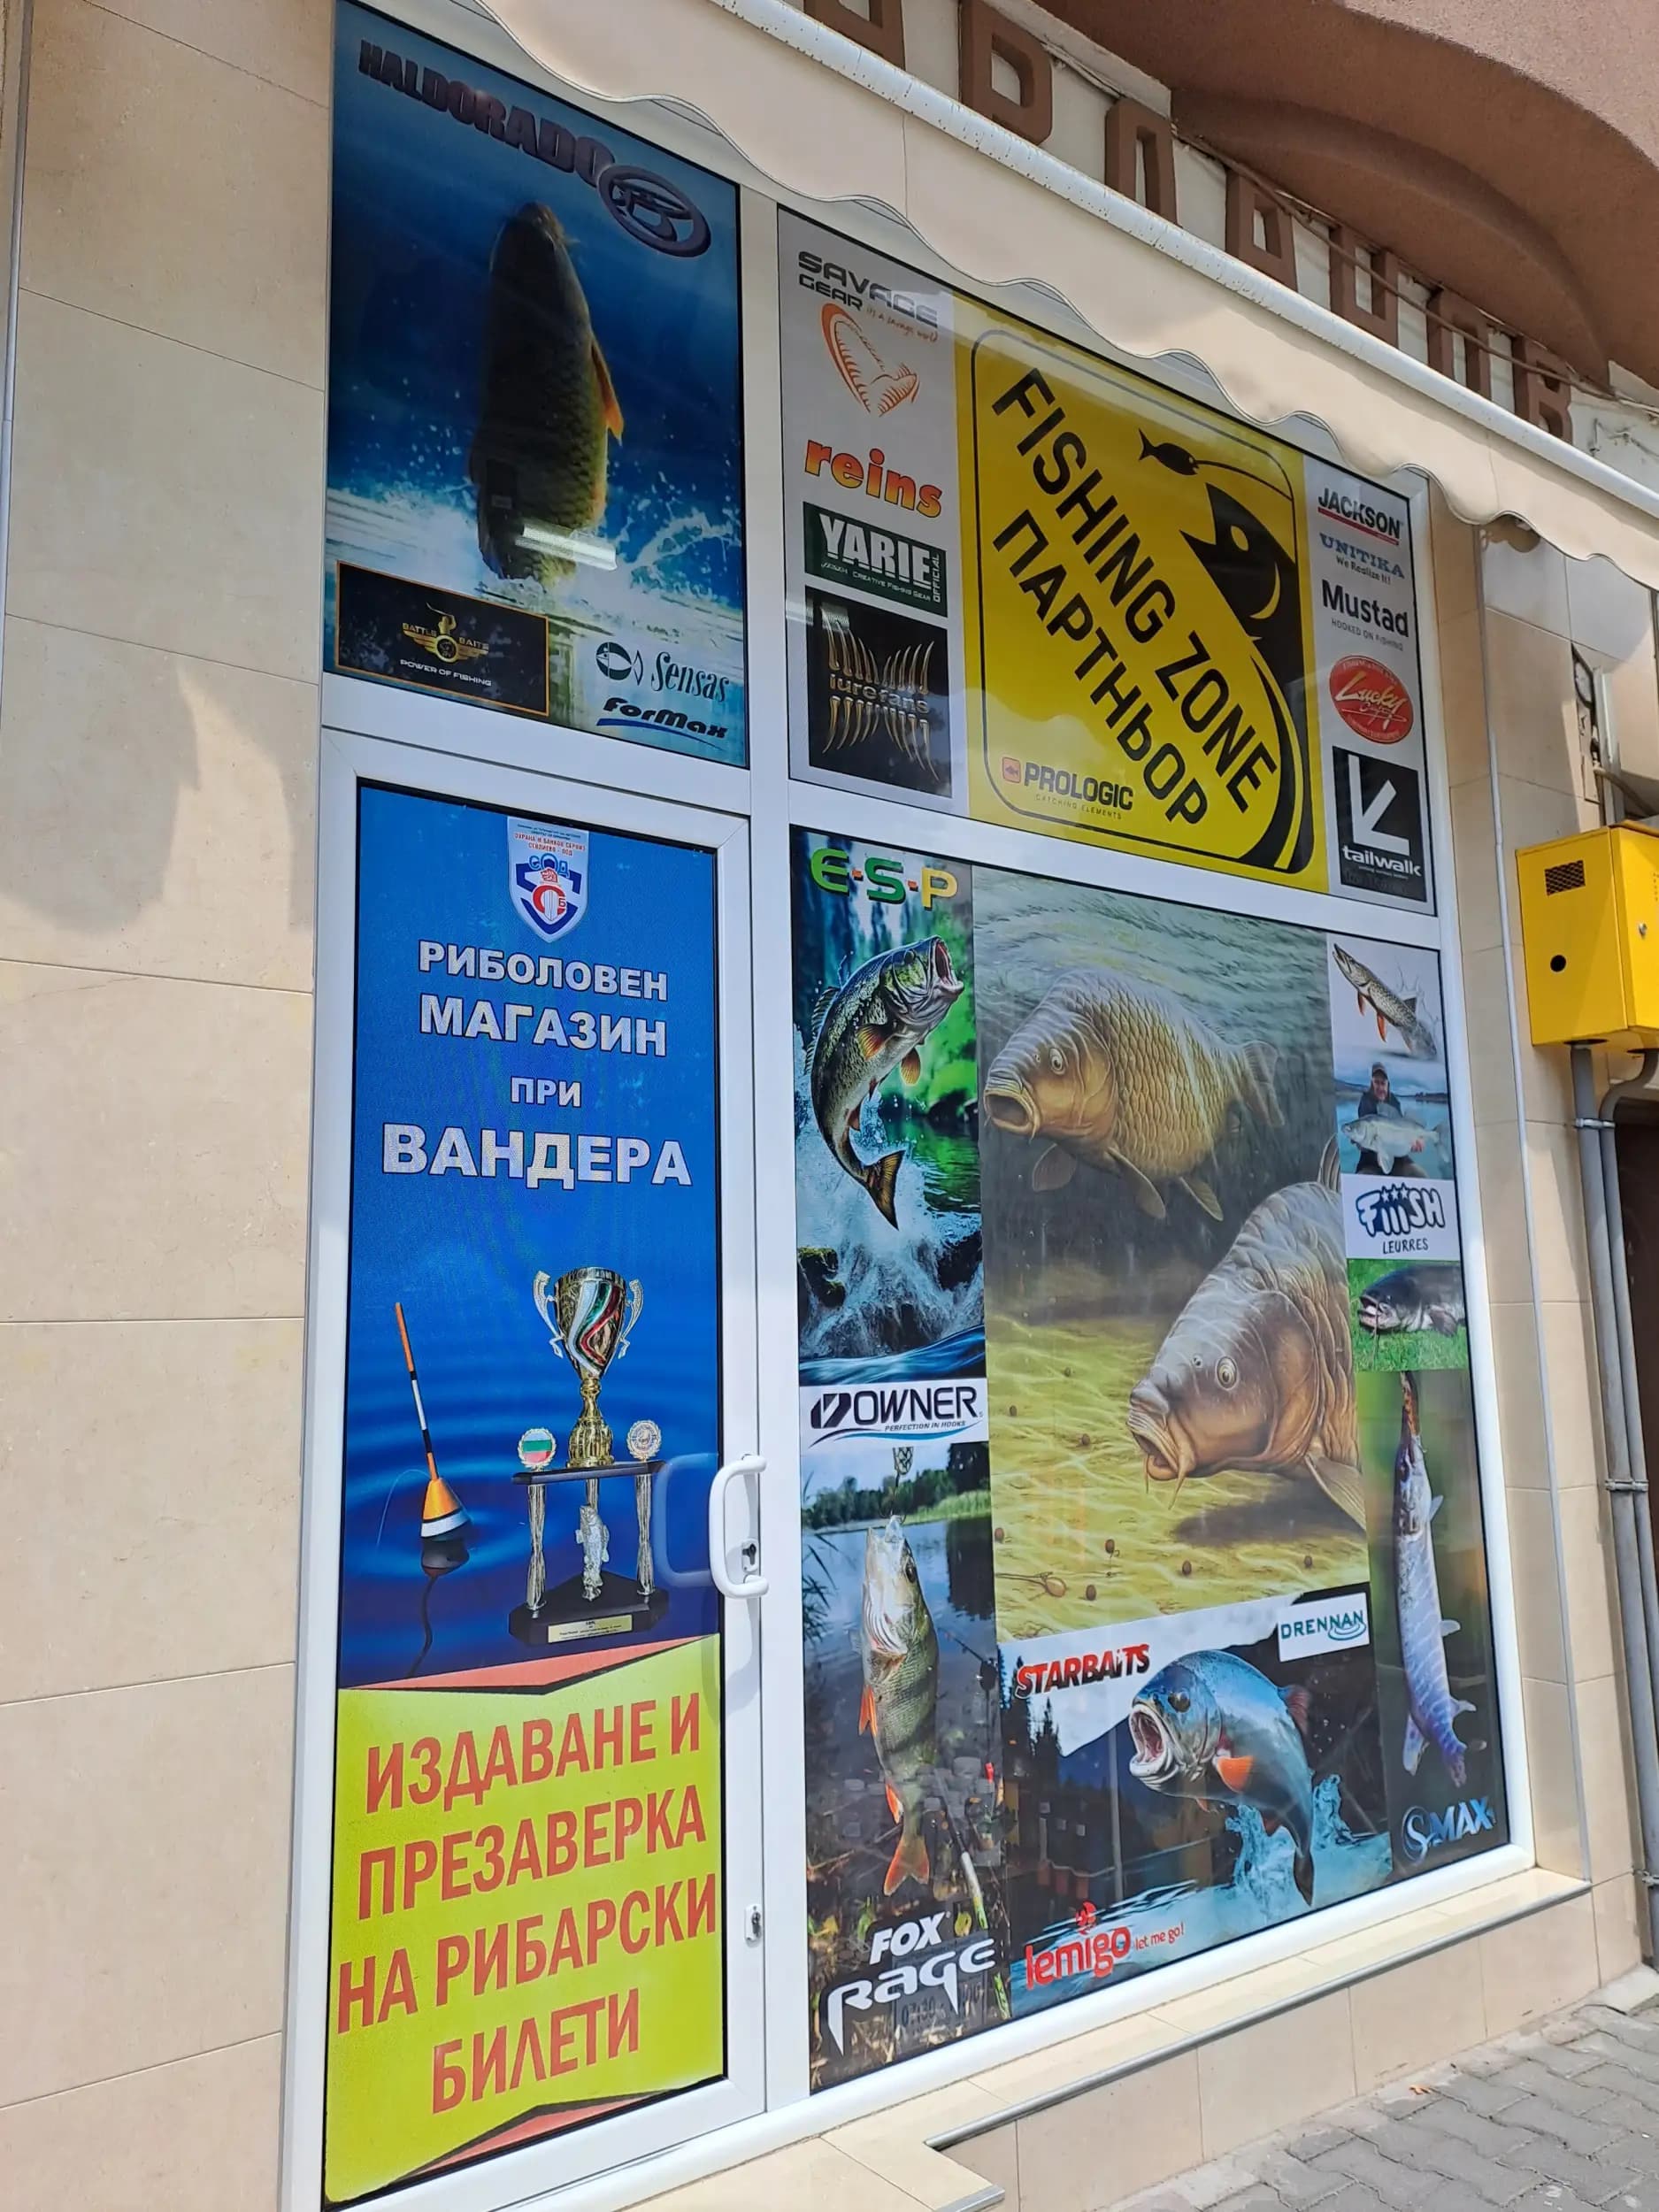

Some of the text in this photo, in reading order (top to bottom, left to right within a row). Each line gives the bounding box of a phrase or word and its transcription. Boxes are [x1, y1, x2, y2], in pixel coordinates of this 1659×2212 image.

[357, 39, 616, 188] HALDORADO
[798, 250, 938, 328] SAVAGE
[799, 274, 864, 311] GEAR
[804, 439, 942, 518] reins
[1318, 488, 1401, 539] JACKSON
[818, 513, 933, 589] YARIE
[1319, 533, 1405, 579] UNITIKA
[853, 571, 887, 587] CREATIVE
[933, 553, 941, 603] OFFICIAL
[992, 368, 1278, 814] FISHING ZONE
[1322, 580, 1409, 637] Mustad
[1332, 618, 1362, 635] HOOKED
[1363, 629, 1374, 640] ON
[400, 659, 437, 673] POWER
[453, 672, 492, 687] FISHING
[651, 651, 731, 703] Sensas
[993, 509, 1209, 825] ПАРТНЬОР
[1024, 762, 1133, 810] PROLOGIC
[1035, 794, 1122, 819] CATCHING ELEMENTS
[1341, 845, 1422, 877] tailwalk
[419, 940, 668, 1002] РИБОЛОВЕН
[420, 993, 666, 1056] МАГАЗИН
[510, 1076, 581, 1108] ПРИ
[382, 1123, 693, 1190] ВАНДЕРА
[1382, 1238, 1428, 1255] LEURRES
[854, 1386, 979, 1425] OWNER
[885, 1423, 930, 1432] PERFECTION
[1280, 1609, 1365, 1640] DRENNAN
[367, 1692, 700, 1814] ИЗДАВАНЕ И
[358, 1785, 706, 1920] ПРЕЗАВЕРКА
[337, 1873, 716, 2033] НА РИБАРСКИ
[870, 1912, 946, 1965] FOX
[1025, 1921, 1184, 1990] lemigo let me go!
[432, 1988, 640, 2115] БИЛЕТИ
